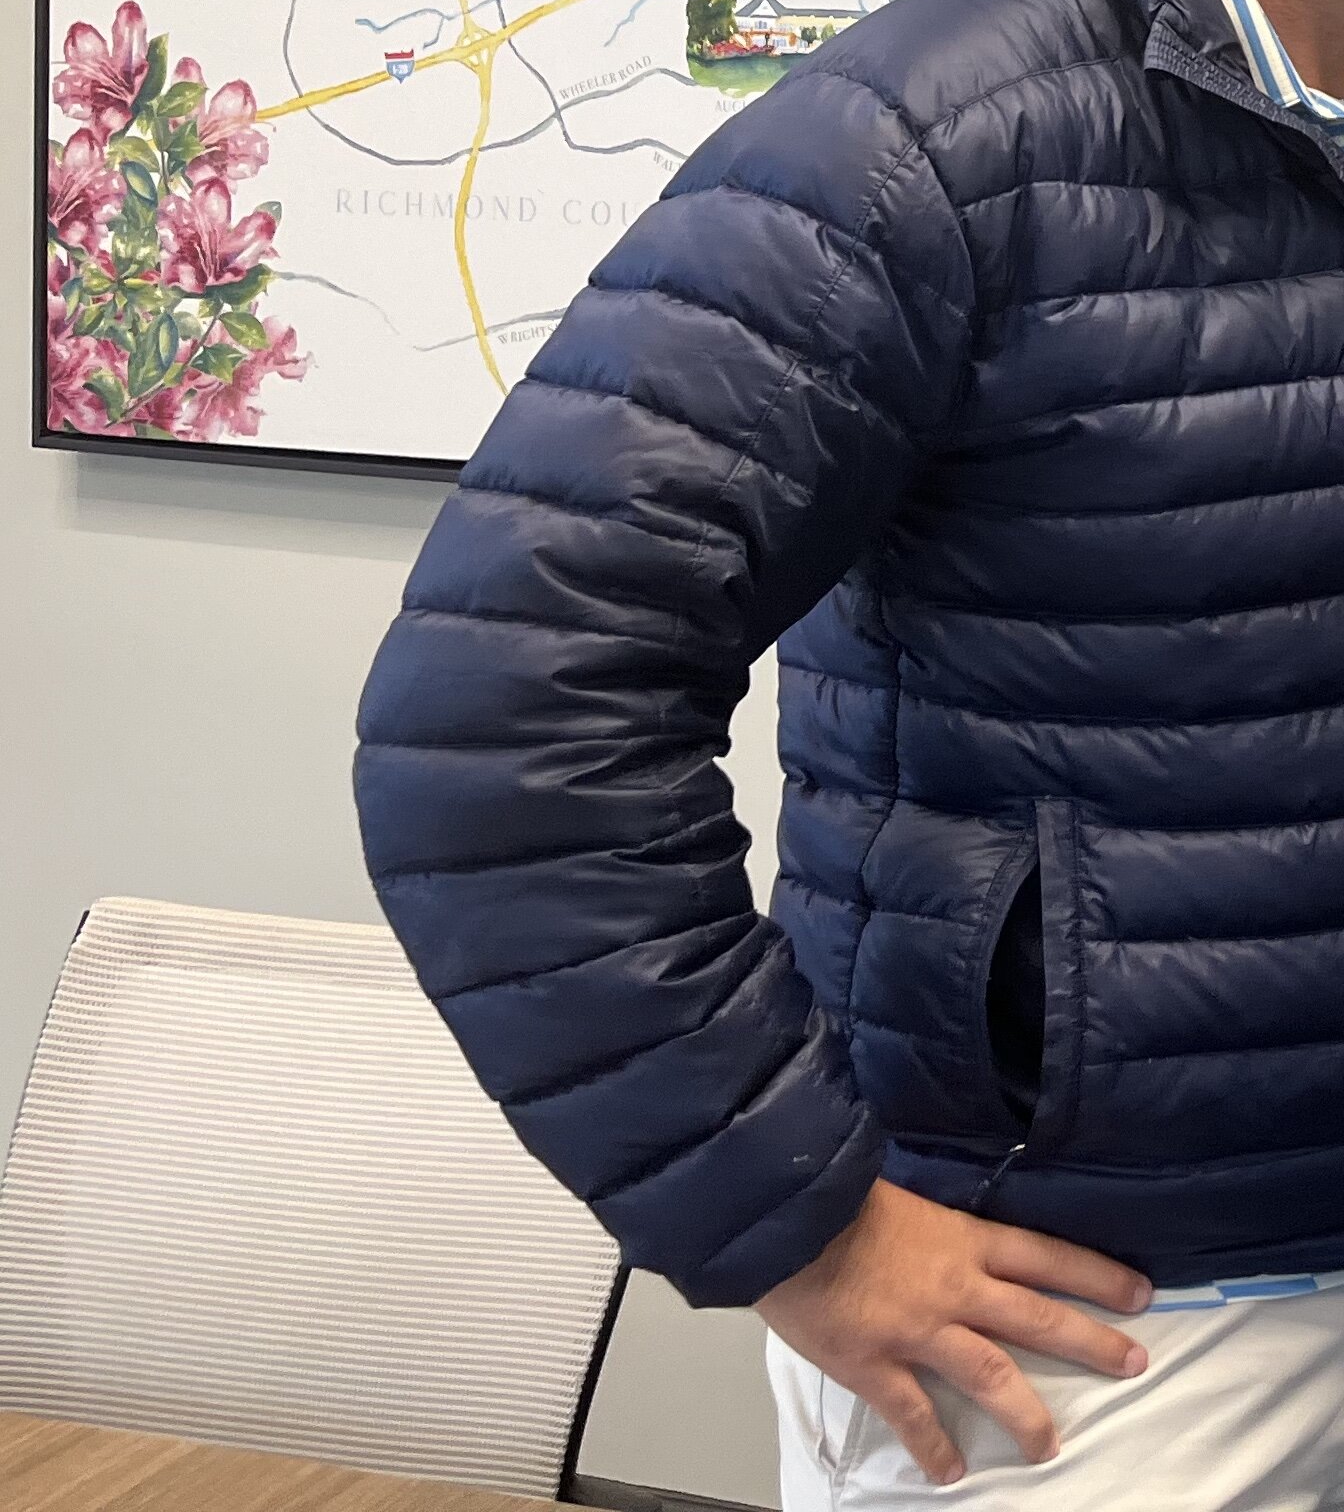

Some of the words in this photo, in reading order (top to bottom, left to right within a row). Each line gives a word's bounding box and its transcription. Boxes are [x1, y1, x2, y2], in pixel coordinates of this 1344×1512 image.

[559, 72, 617, 100] WHEELER
[619, 55, 652, 80] ROAD
[335, 188, 538, 223] RICHMOND
